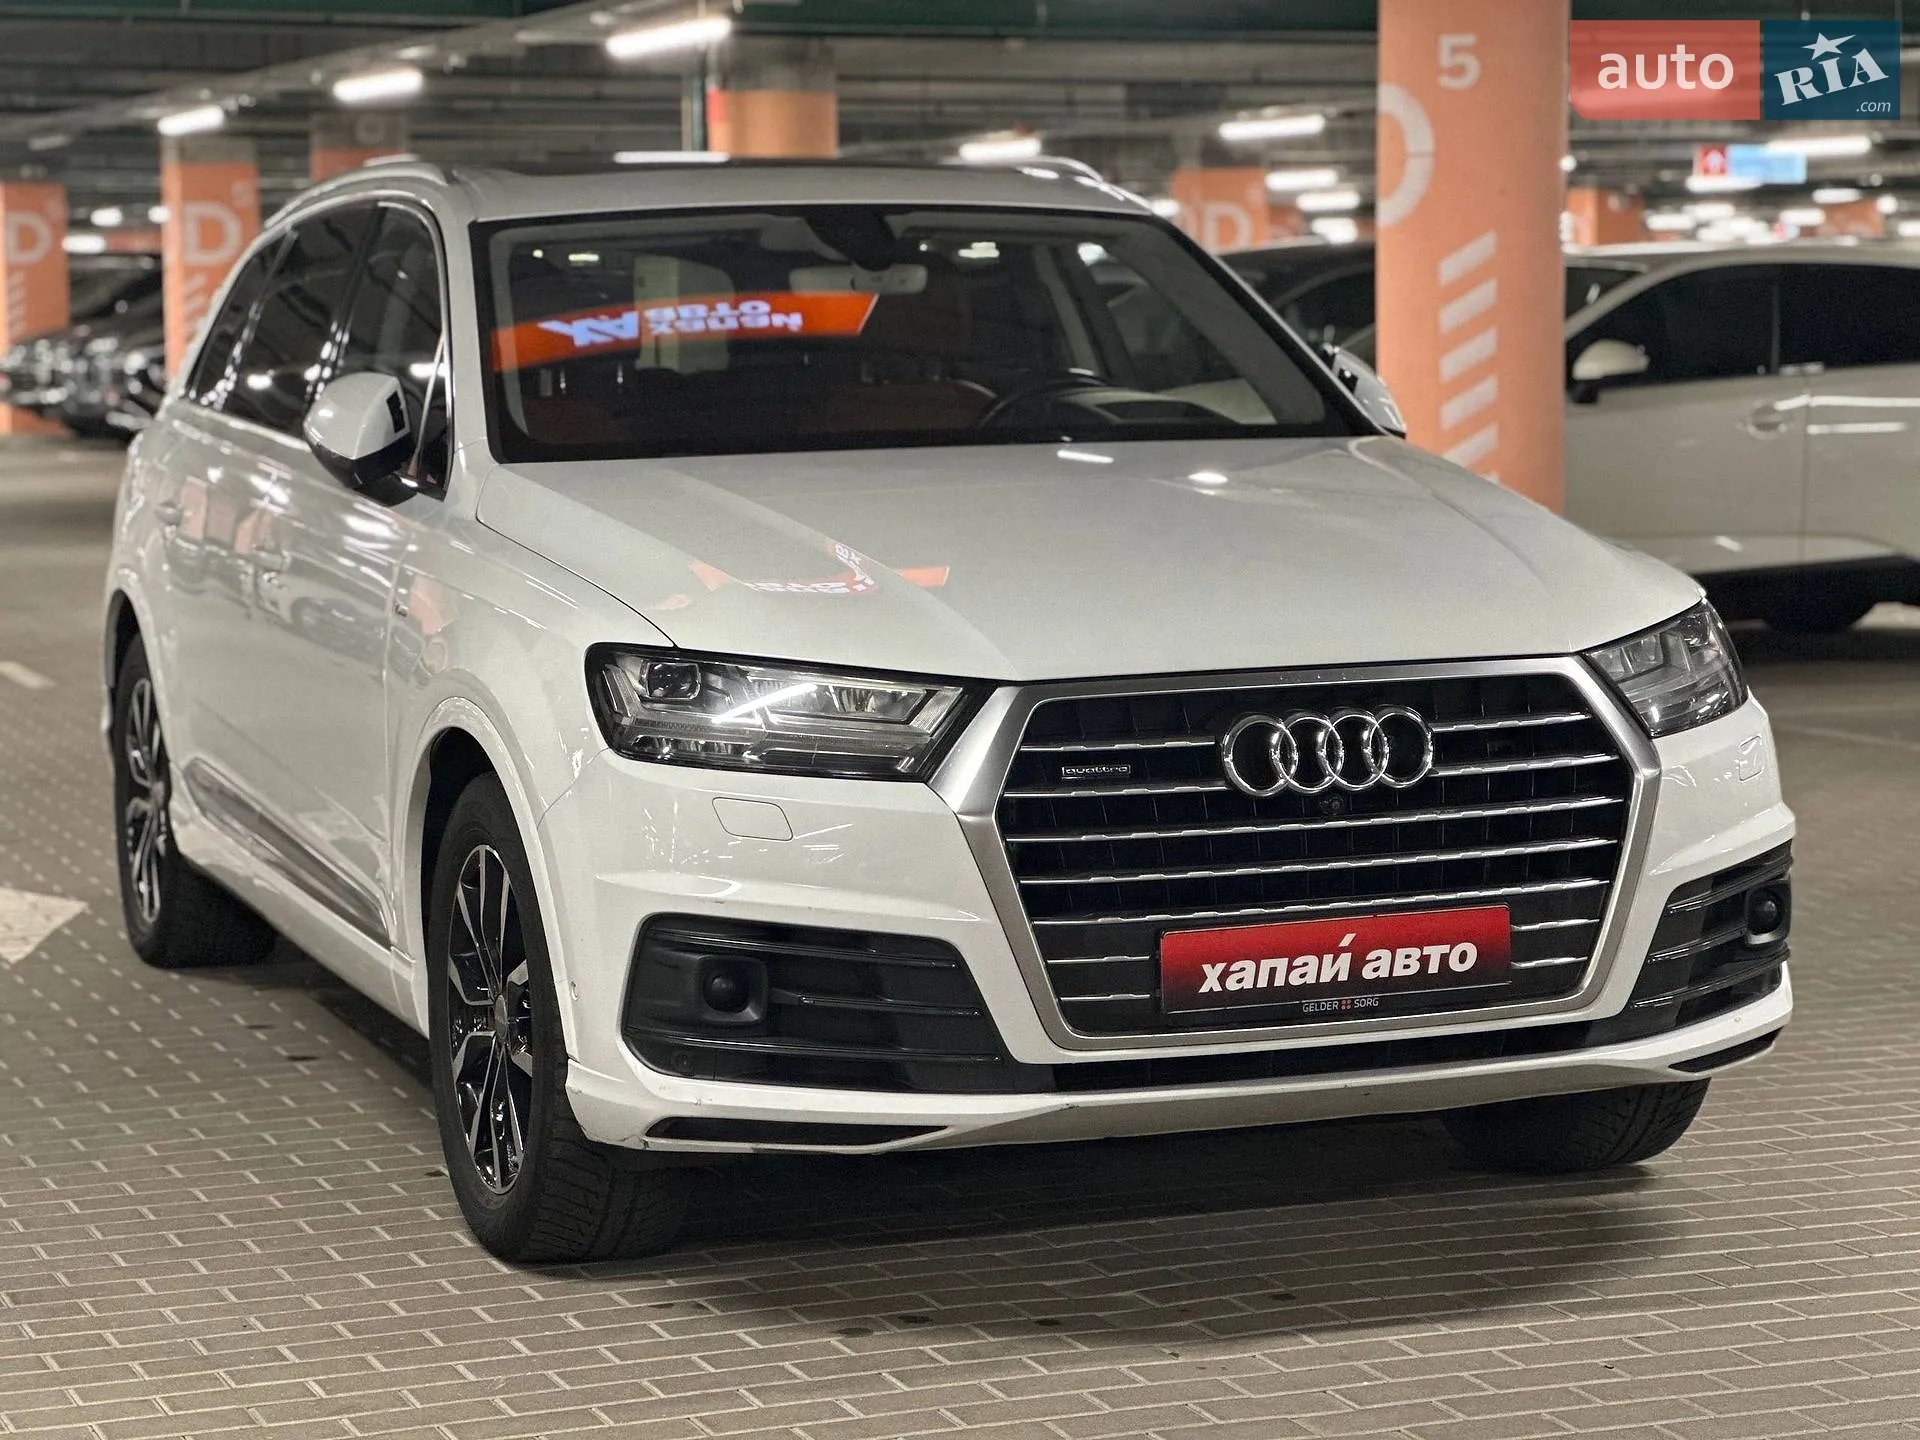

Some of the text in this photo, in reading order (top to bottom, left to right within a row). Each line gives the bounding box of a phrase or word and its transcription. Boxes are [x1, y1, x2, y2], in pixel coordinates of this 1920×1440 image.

[1437, 32, 1482, 91] 5
[5, 211, 53, 264] D
[183, 202, 241, 266] D
[1065, 765, 1128, 776] quattro
[1361, 942, 1478, 980] авто
[1302, 997, 1380, 1013] GELDER SORG
